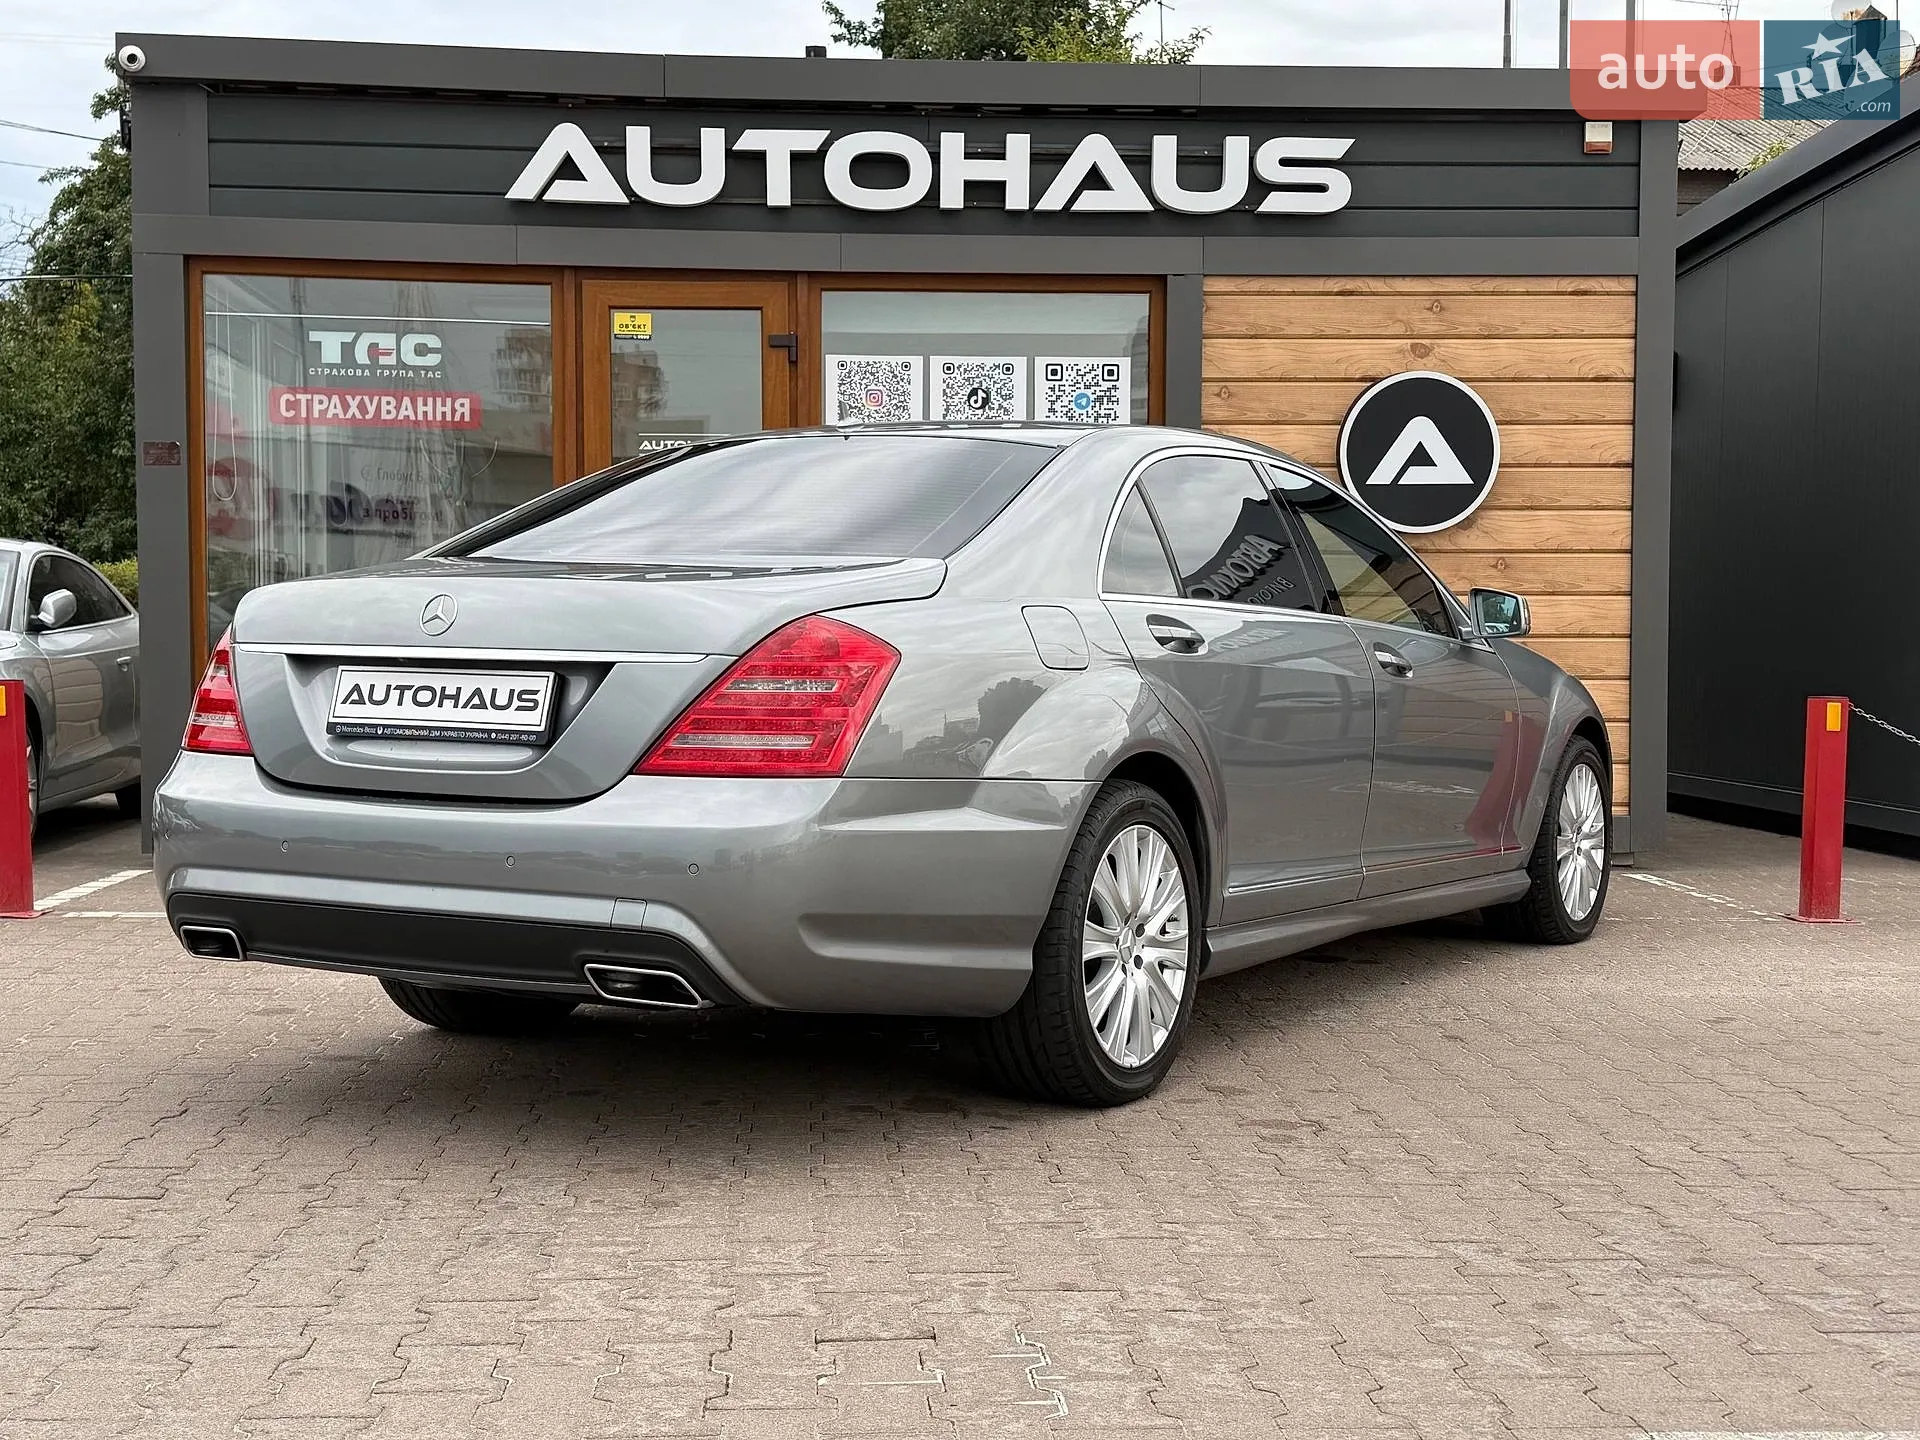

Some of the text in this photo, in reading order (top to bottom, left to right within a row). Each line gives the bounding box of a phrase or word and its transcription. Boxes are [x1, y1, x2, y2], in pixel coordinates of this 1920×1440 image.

[503, 121, 1357, 215] AUTOHAUS
[308, 368, 443, 378] СТРАХОВА ГРУПА ТАС
[279, 393, 471, 422] СТРАХУВАННЯ
[638, 440, 692, 450] AUTO
[340, 683, 542, 712] AUTOHAUS
